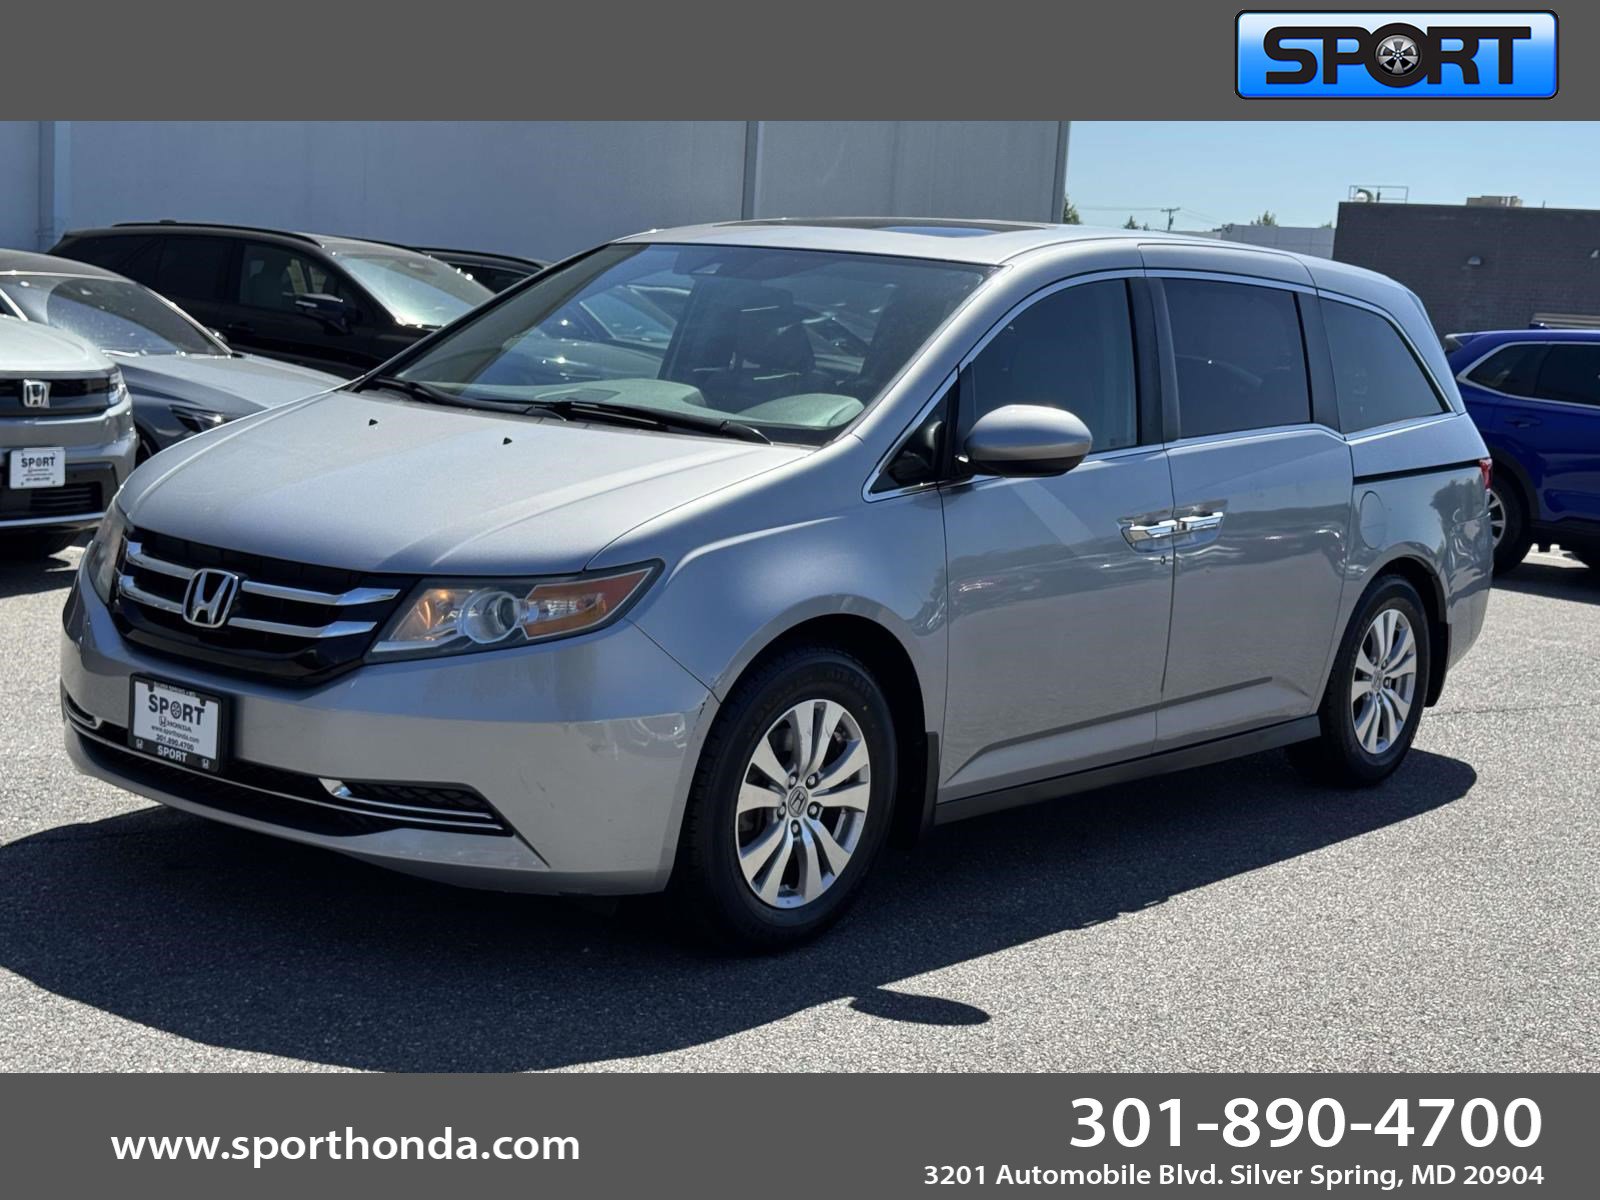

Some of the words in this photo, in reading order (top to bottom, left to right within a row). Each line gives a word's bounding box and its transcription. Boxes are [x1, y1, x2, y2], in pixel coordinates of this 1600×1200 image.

[21, 456, 56, 468] SPORT
[148, 694, 205, 726] SPORT
[167, 720, 192, 733] HONDA
[157, 744, 188, 762] SPORT
